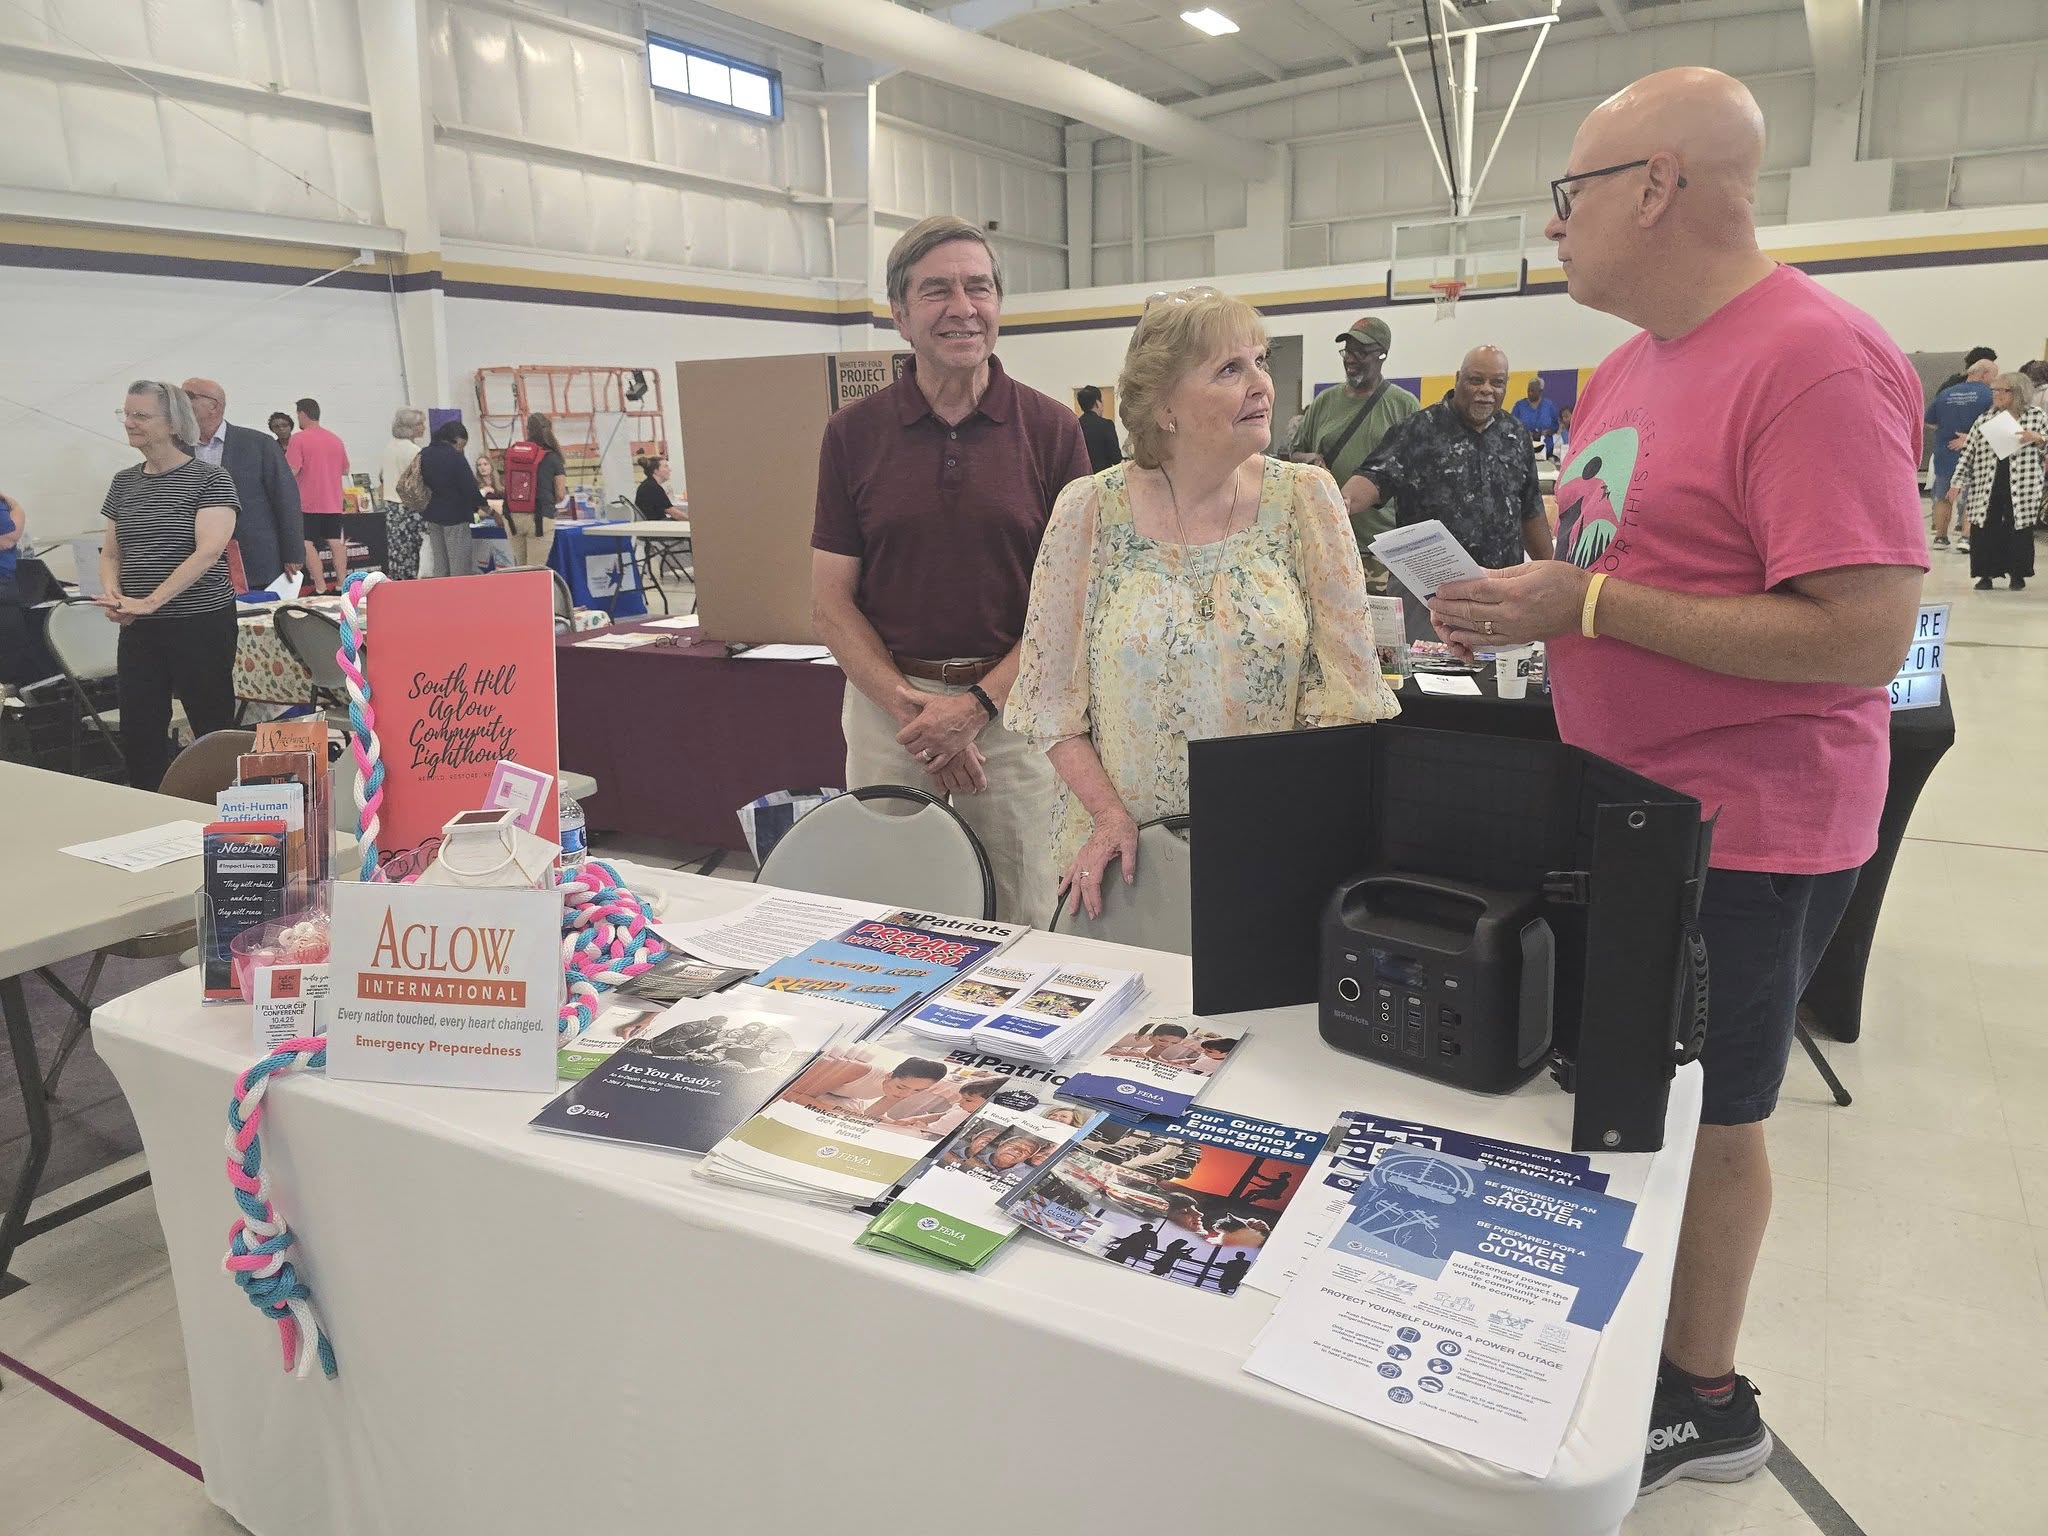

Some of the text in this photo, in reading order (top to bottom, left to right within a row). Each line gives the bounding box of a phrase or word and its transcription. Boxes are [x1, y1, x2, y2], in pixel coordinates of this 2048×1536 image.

[840, 368, 886, 382] PROJECT
[841, 383, 880, 398] BOARD
[1583, 407, 1656, 446] OUNGLIFE
[1623, 470, 1649, 527] THIS
[408, 662, 517, 699] South Hill
[428, 690, 496, 730] Aglow
[409, 714, 518, 750] Community
[410, 734, 518, 778] Lighthouse
[222, 802, 289, 812] Anti-Human
[217, 842, 277, 856] New Day
[900, 911, 1012, 937] 4Patriots
[370, 904, 516, 975] AGLOW
[844, 934, 963, 966] WITH PEDRO
[856, 923, 979, 958] PREPARE
[763, 975, 854, 992] READY
[980, 969, 1029, 981] PREPAREDNESS
[983, 966, 1034, 979] EMERGENCY
[1054, 978, 1105, 991] PREPAREDNESS
[1058, 973, 1111, 986] EMERGENCY
[364, 978, 518, 1001] INTERNATIONAL
[271, 1016, 295, 1024] 10.4.25
[337, 1007, 544, 1034] Every nation touched, every heart changed.
[355, 1035, 522, 1057] Emergency Preparedness
[616, 1063, 721, 1088] Are You Ready?
[944, 1049, 1070, 1086] 4Patrio
[1136, 1090, 1164, 1102] FEMA
[582, 1108, 610, 1119] FEMA
[804, 1103, 875, 1129] Makes Sense.
[815, 1115, 871, 1134] Get Ready
[832, 1105, 883, 1124] Preparing
[990, 1112, 1010, 1124] Ready
[1021, 1119, 1041, 1132] Ready
[1181, 1110, 1318, 1143] Your Guide To
[835, 1129, 862, 1140] Now.
[1165, 1124, 1306, 1160] Preparedness
[1186, 1119, 1297, 1150] Emergency
[838, 1152, 872, 1167] FEMA
[1480, 1152, 1495, 1160] BE
[1495, 1155, 1549, 1173] PREPARED
[1550, 1168, 1573, 1179] FOR
[1484, 1180, 1598, 1215] BE PREPARED FOR AN
[1499, 1191, 1574, 1217] ACTIVE
[1047, 1209, 1075, 1224] CLOSED
[1055, 1205, 1077, 1217] ROAD
[1482, 1195, 1583, 1229] SHOOTER
[936, 1225, 967, 1241] FEMA
[1476, 1220, 1492, 1229] BE
[1493, 1225, 1551, 1246] PREPARED
[1552, 1242, 1577, 1254] FOR
[1362, 1246, 1389, 1259] FEMA
[1478, 1242, 1568, 1275] OUTAGE
[1486, 1232, 1567, 1263] POWER
[1451, 1262, 1569, 1301] outages may impact the
[1453, 1269, 1562, 1306] whole community and
[1473, 1261, 1553, 1290] Extended power
[1470, 1281, 1536, 1306] the economy.
[1320, 1286, 1366, 1306] PROTECT
[1368, 1302, 1421, 1324] YOURSELF
[1422, 1319, 1464, 1338] DURING
[1474, 1337, 1515, 1355] POWER
[1517, 1351, 1563, 1371] OUTAGE
